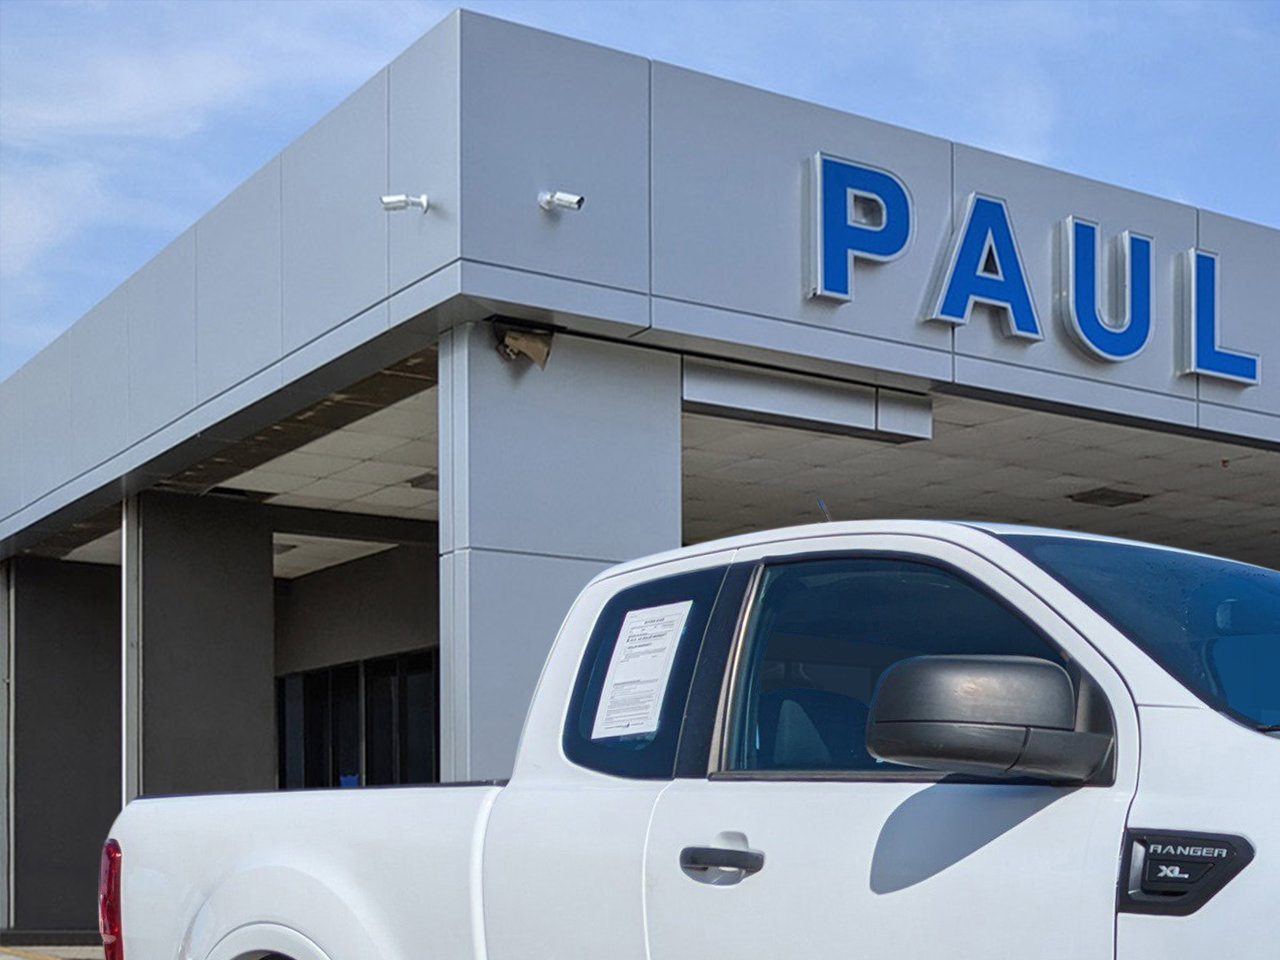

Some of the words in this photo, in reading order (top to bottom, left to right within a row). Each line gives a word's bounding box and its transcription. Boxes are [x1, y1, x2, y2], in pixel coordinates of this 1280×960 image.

[812, 151, 1261, 386] PAUL
[1148, 844, 1228, 858] RANGER
[1157, 865, 1189, 879] XL
